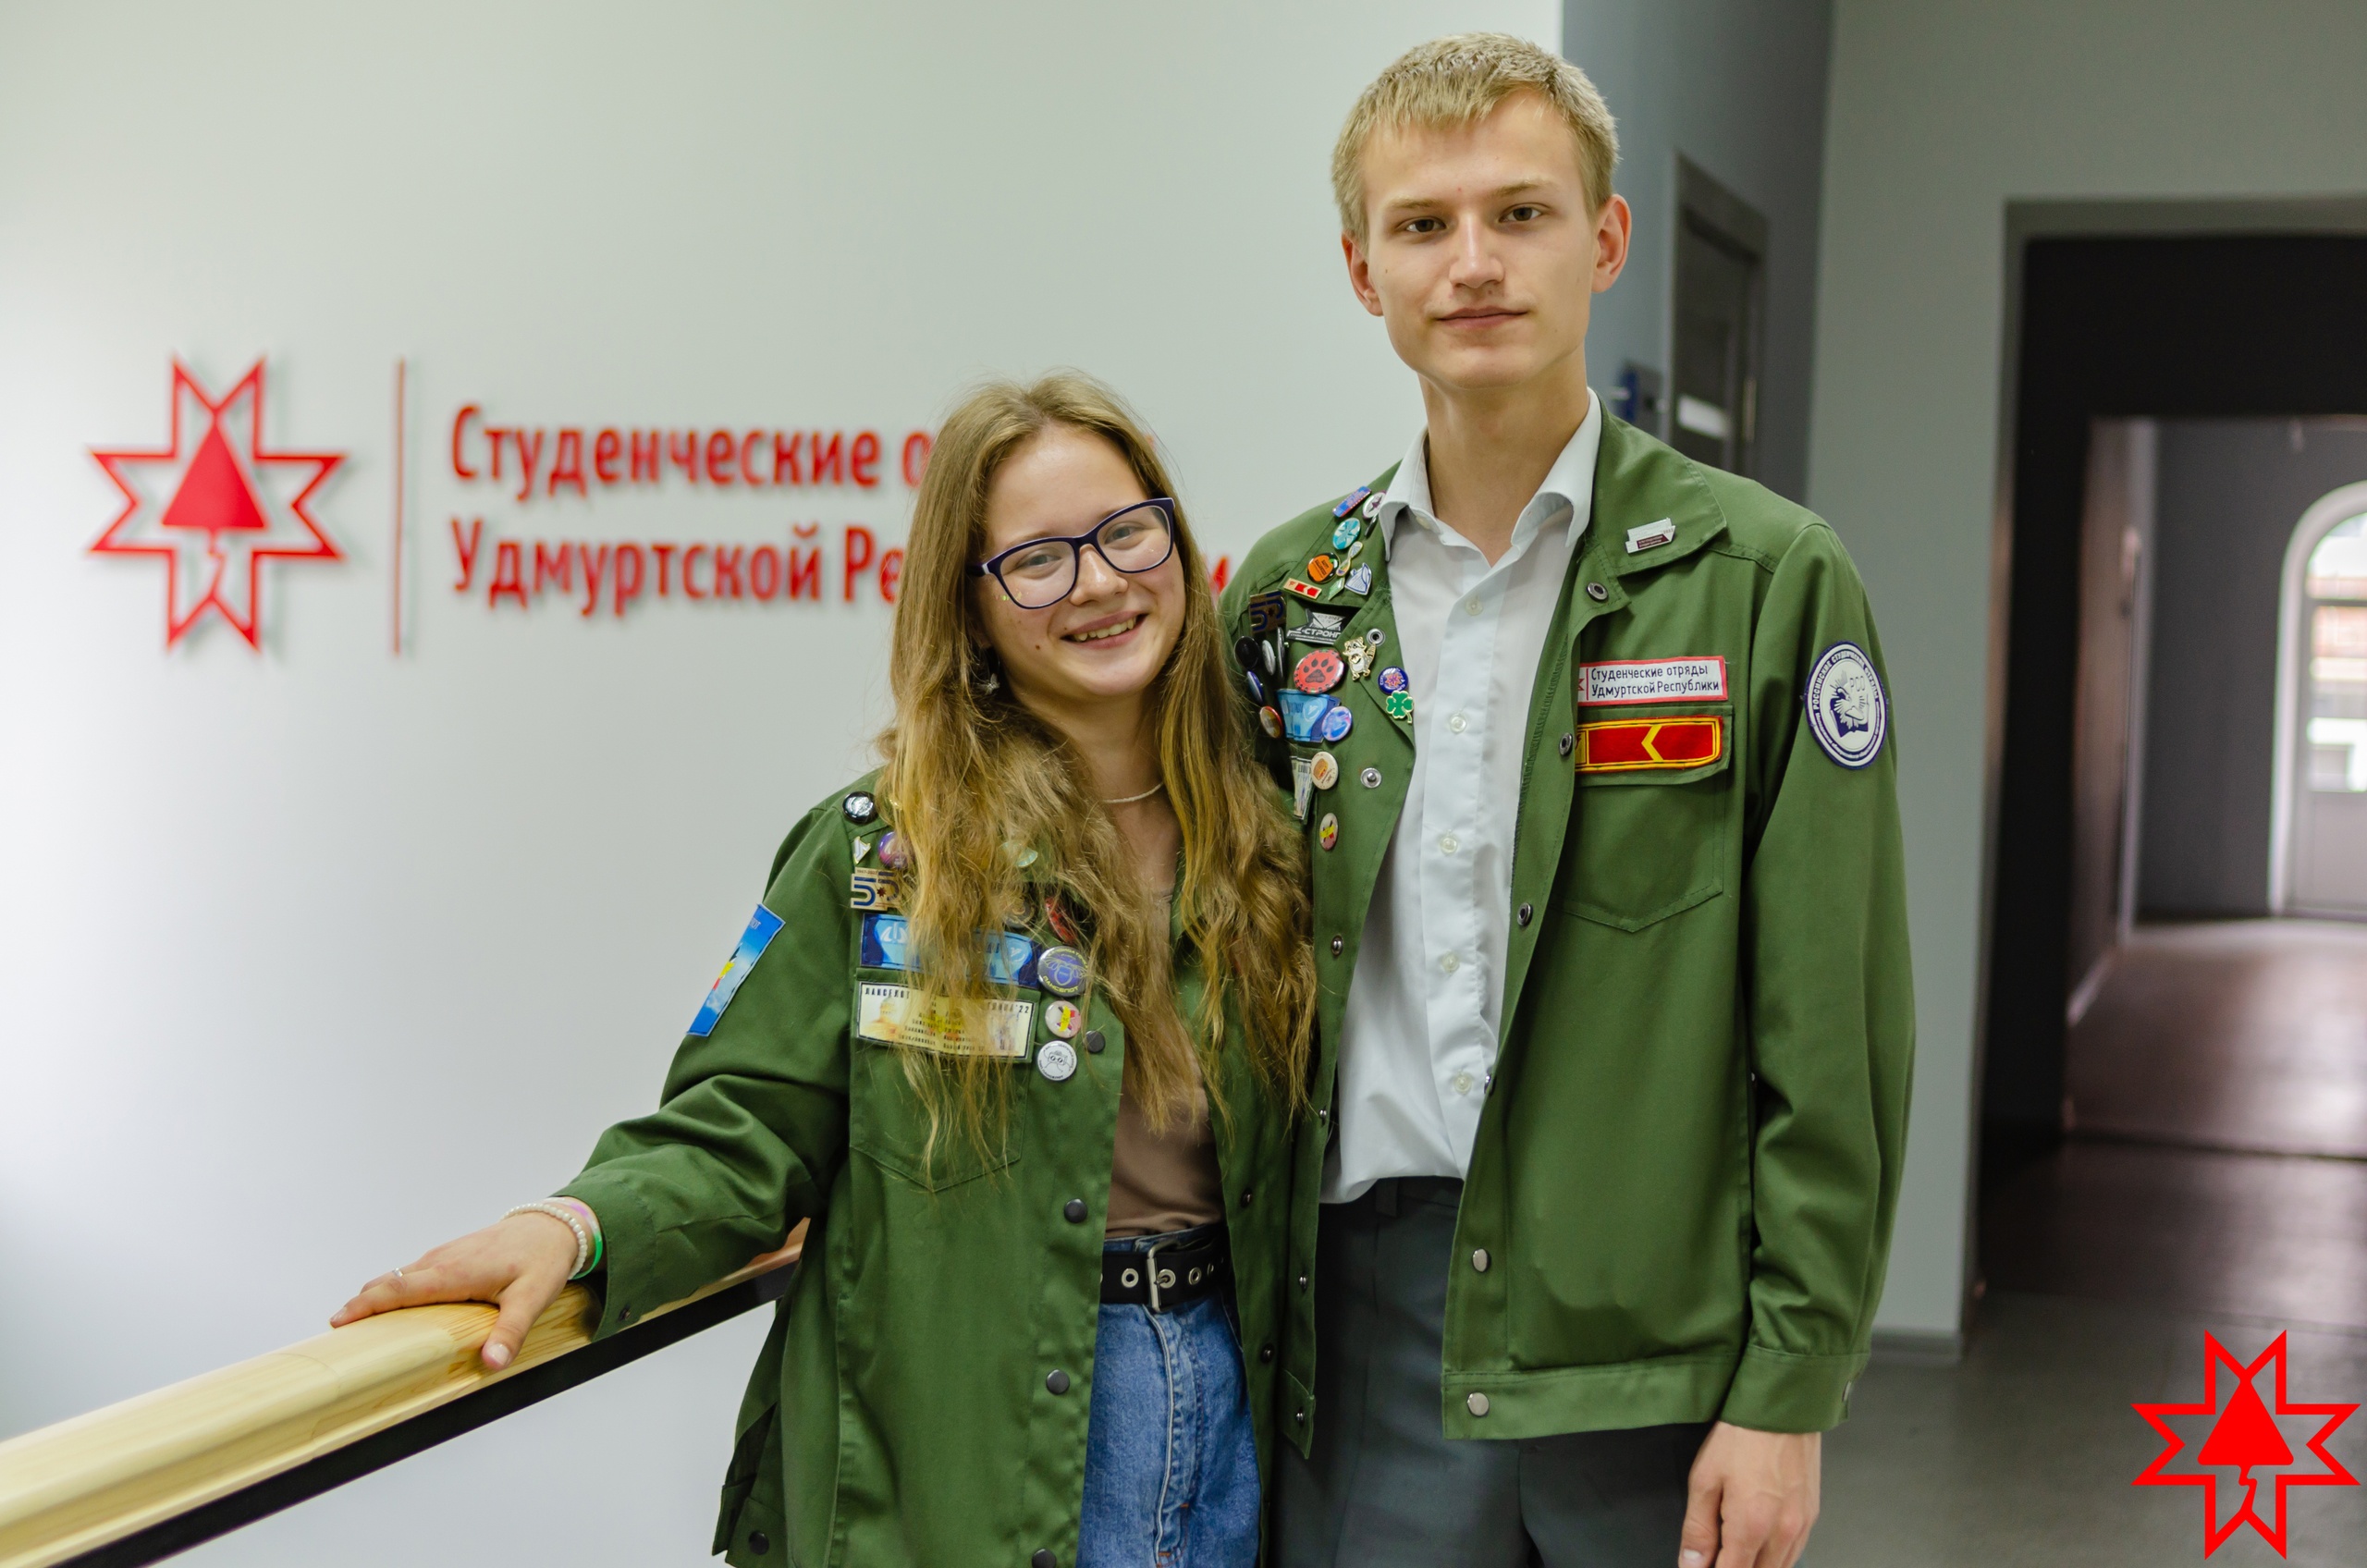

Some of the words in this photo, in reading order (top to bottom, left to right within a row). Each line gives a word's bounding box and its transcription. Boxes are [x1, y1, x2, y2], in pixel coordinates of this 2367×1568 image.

[452, 404, 880, 502] Студенческие
[452, 518, 821, 617] Удмуртской
[1591, 668, 1662, 682] Студенческие
[1666, 665, 1708, 677] отряды
[1591, 682, 1655, 698] Удмуртской
[1657, 680, 1719, 693] Республики
